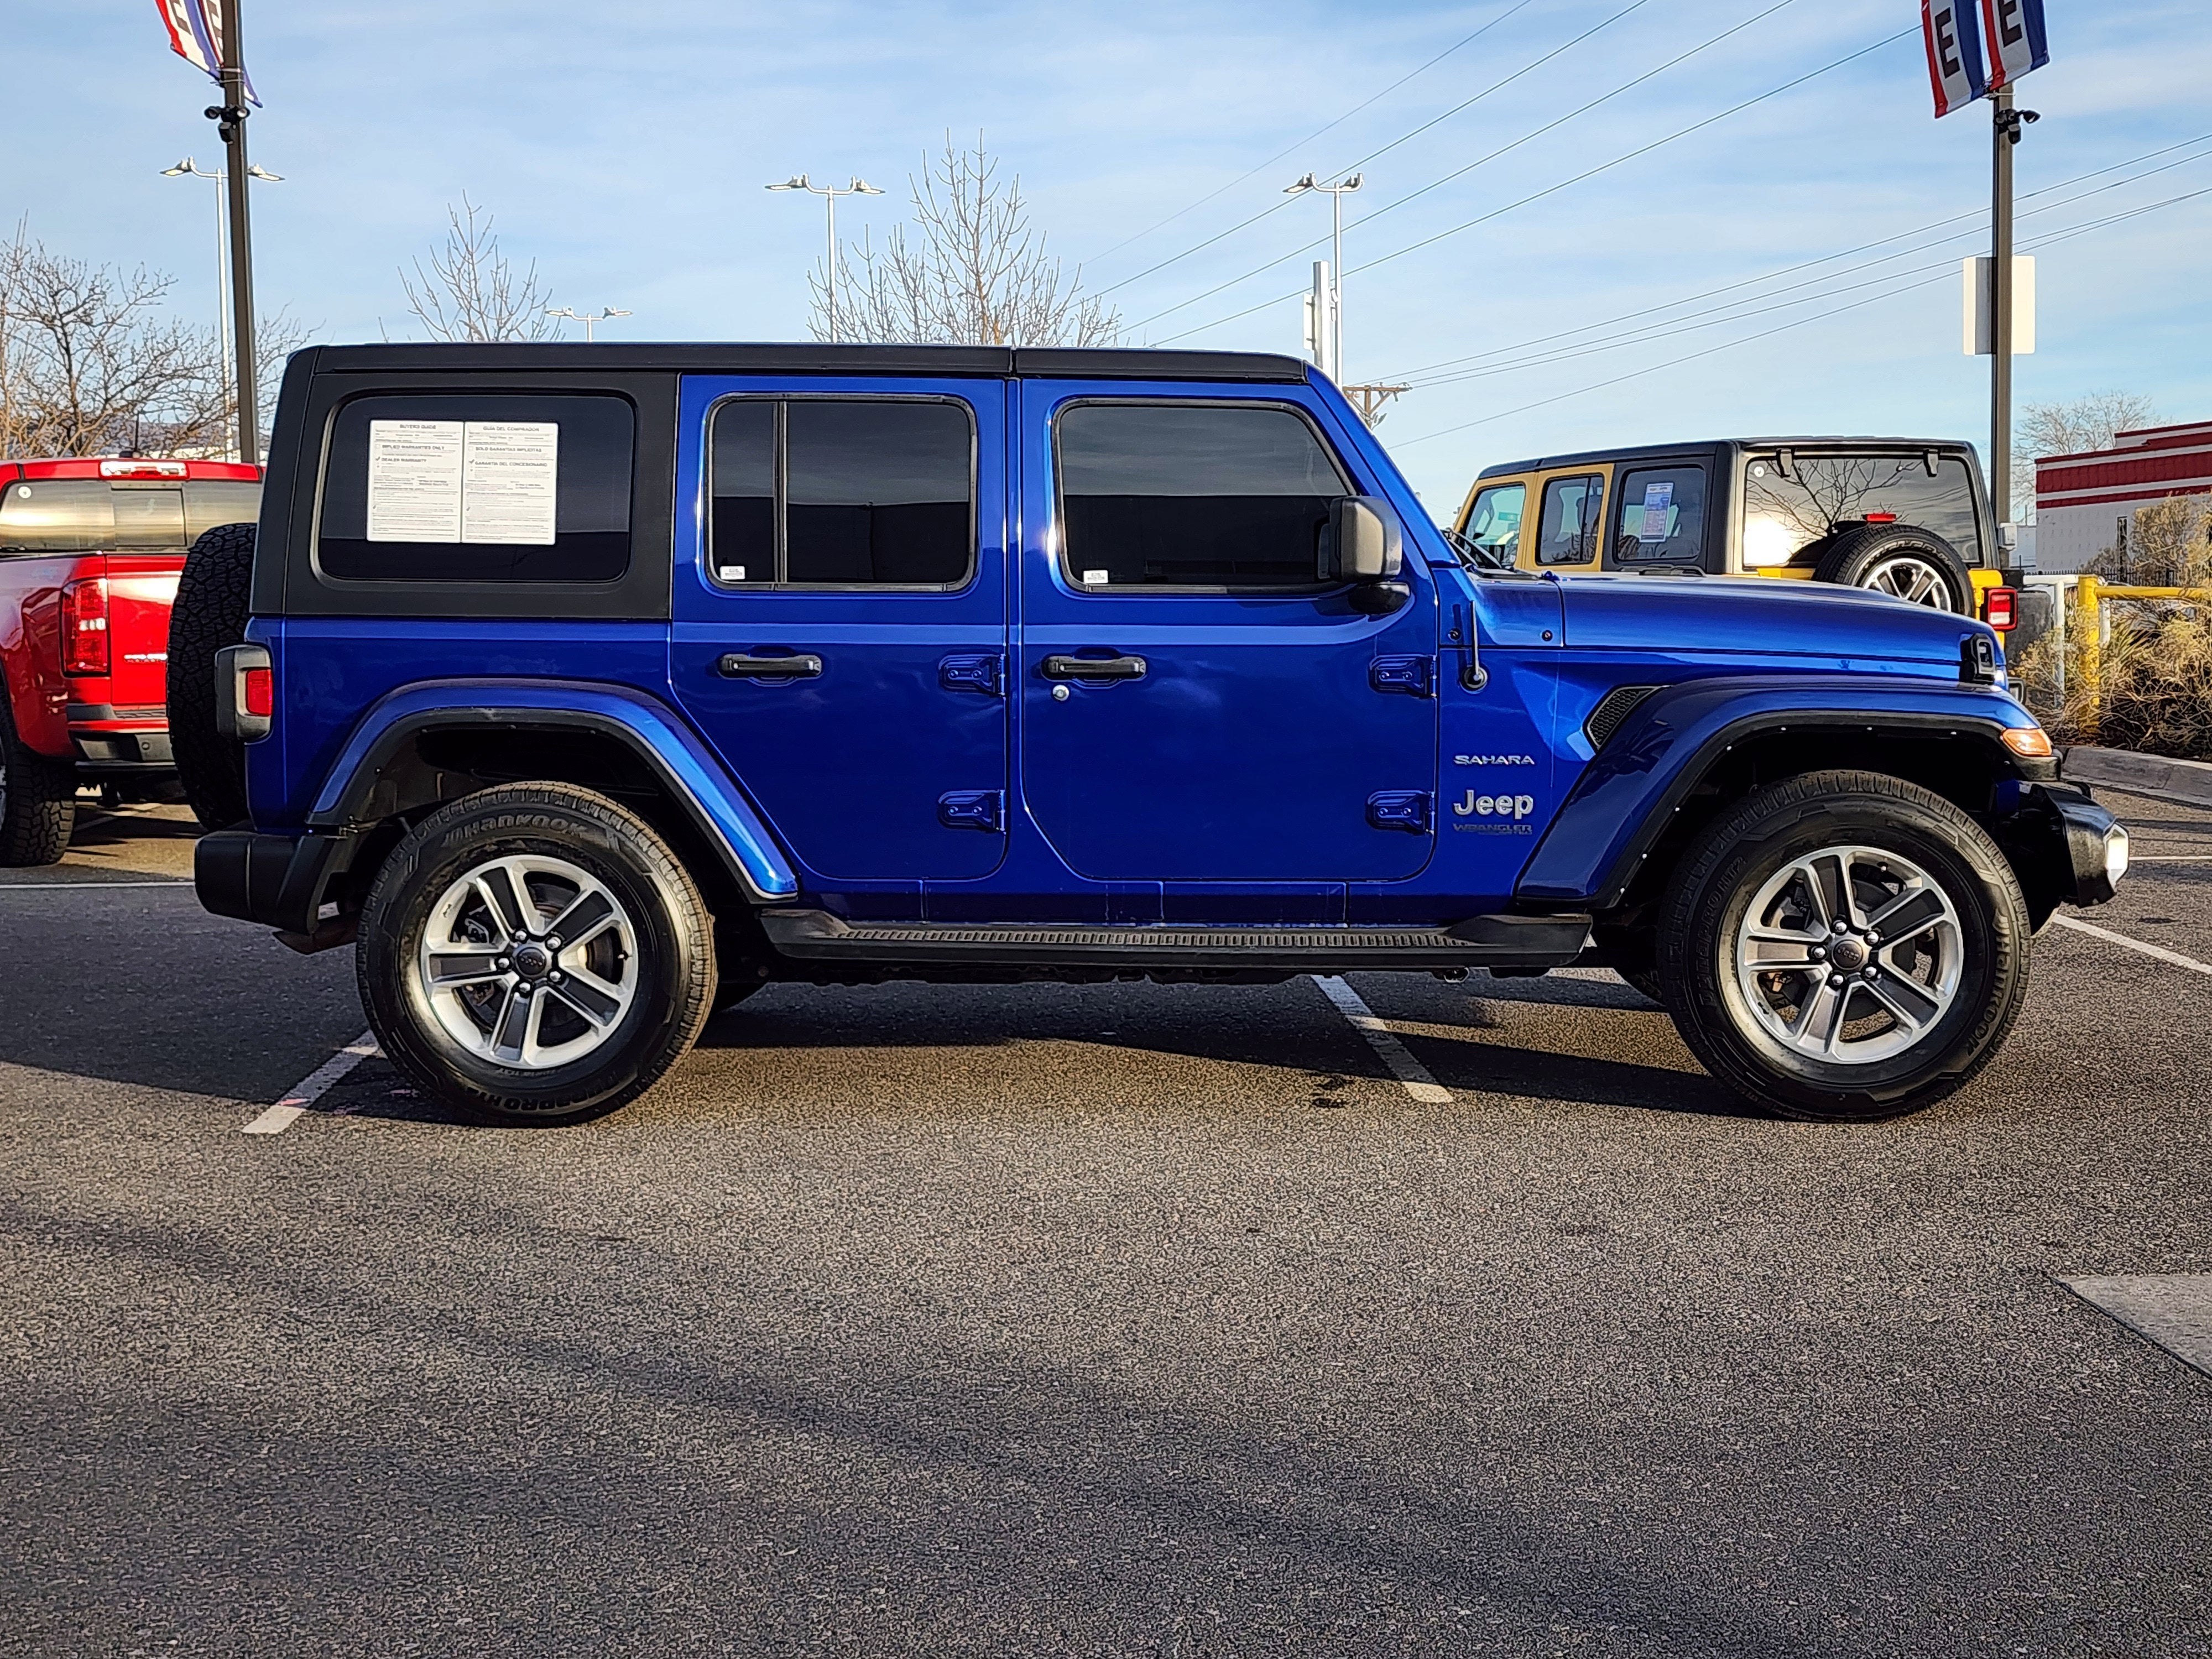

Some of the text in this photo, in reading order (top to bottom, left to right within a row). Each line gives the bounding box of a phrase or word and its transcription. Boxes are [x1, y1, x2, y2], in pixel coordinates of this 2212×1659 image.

[1935, 7, 1960, 79] E
[1453, 755, 1535, 765] SAHARA
[1453, 789, 1533, 820] Jeep
[1453, 823, 1532, 832] WRANGLER
